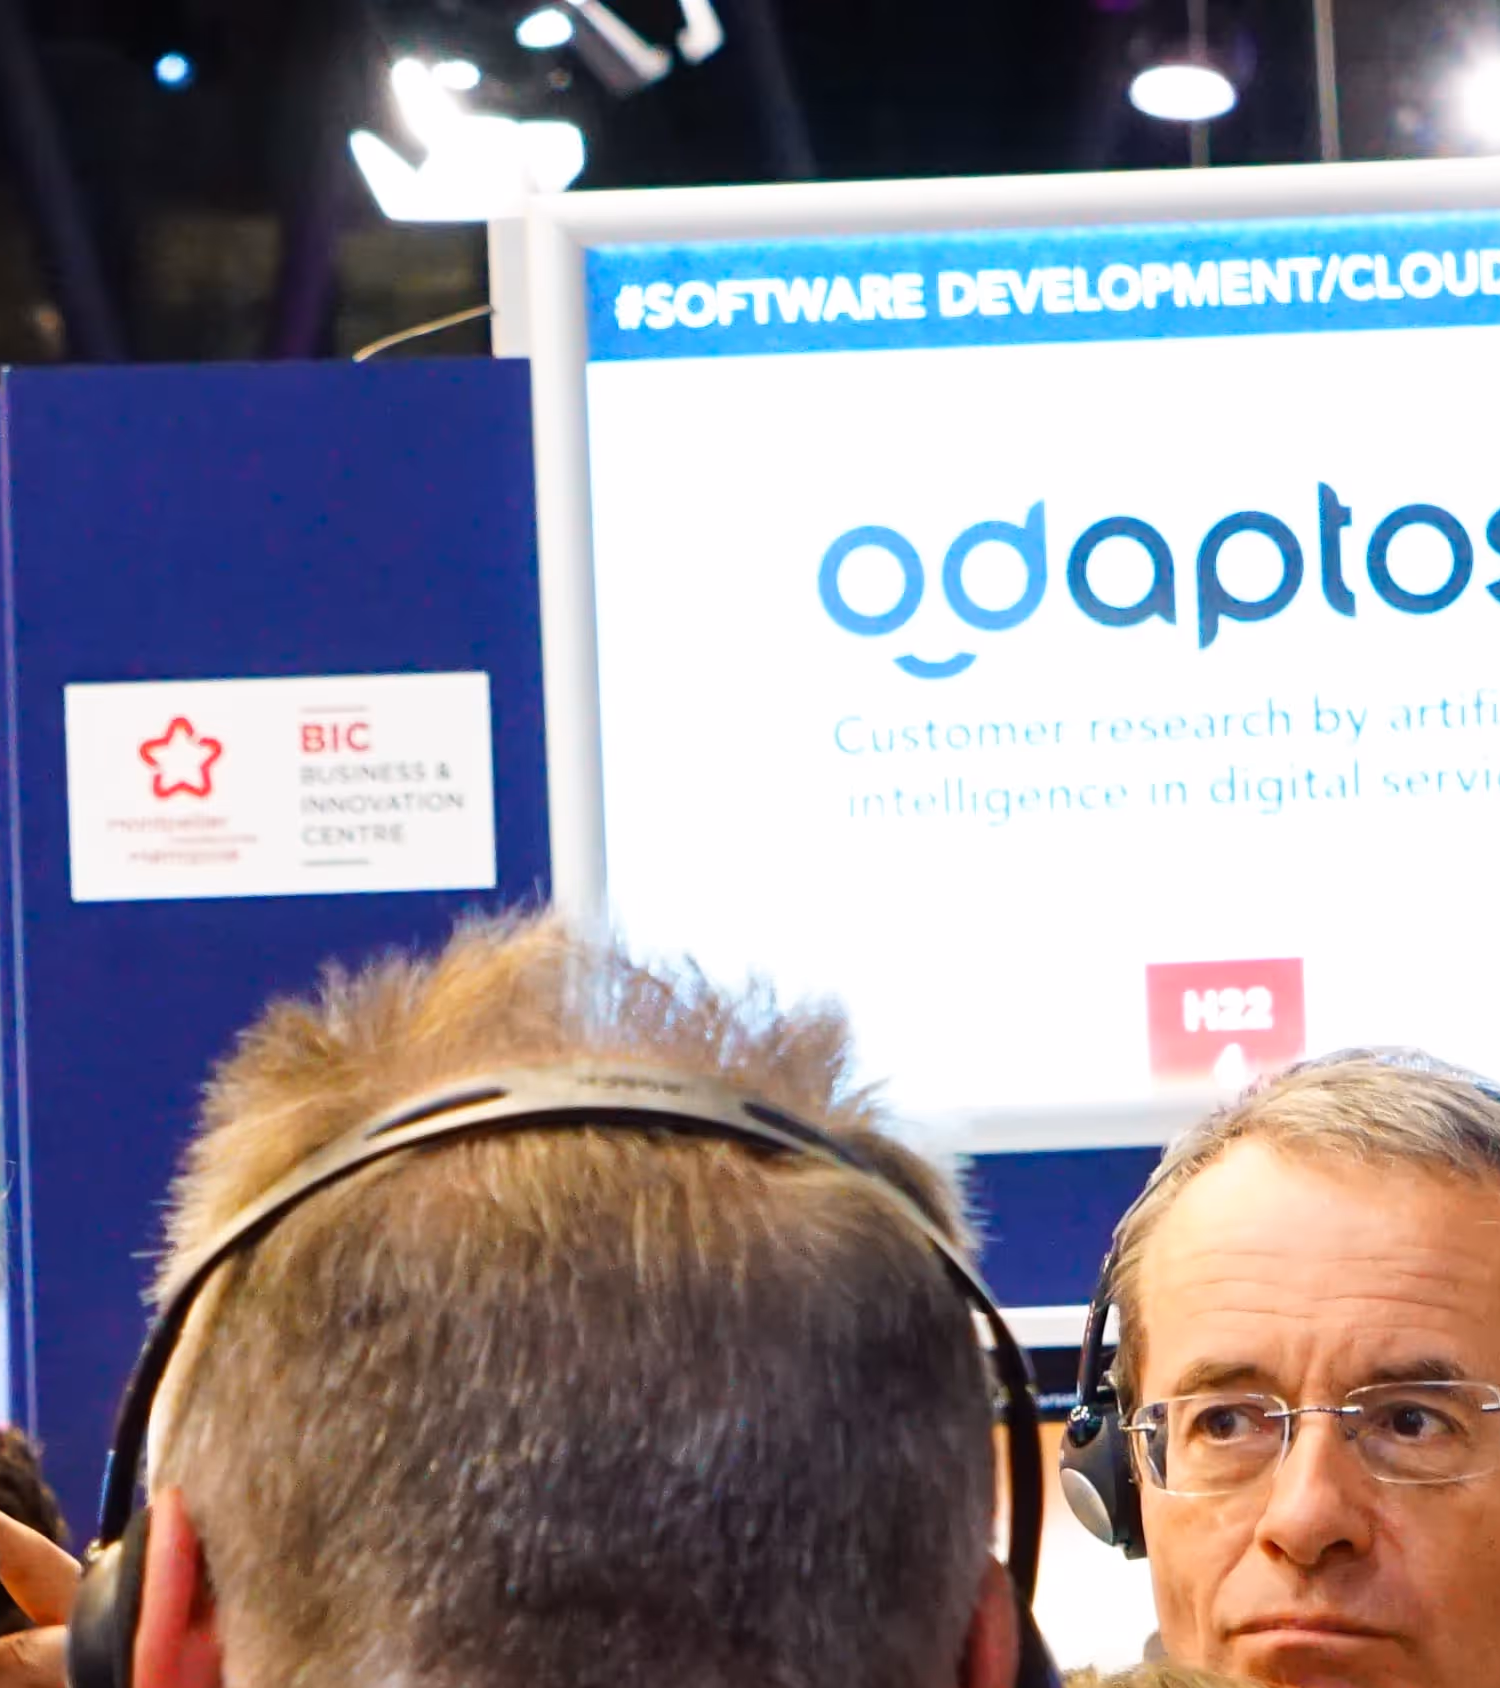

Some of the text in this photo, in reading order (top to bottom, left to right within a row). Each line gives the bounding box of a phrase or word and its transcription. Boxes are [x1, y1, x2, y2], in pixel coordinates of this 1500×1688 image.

[613, 272, 927, 330] #SOFTWARE
[299, 720, 372, 756] BIC
[832, 713, 1066, 756] Customer
[1087, 696, 1293, 745] research
[1312, 691, 1369, 746] by
[300, 763, 425, 784] BUSINESS
[300, 791, 466, 815] INNOVATION
[847, 774, 1129, 828] intelligence
[1148, 778, 1189, 808] in
[1208, 756, 1362, 816] digital
[301, 824, 405, 847] CENTRE
